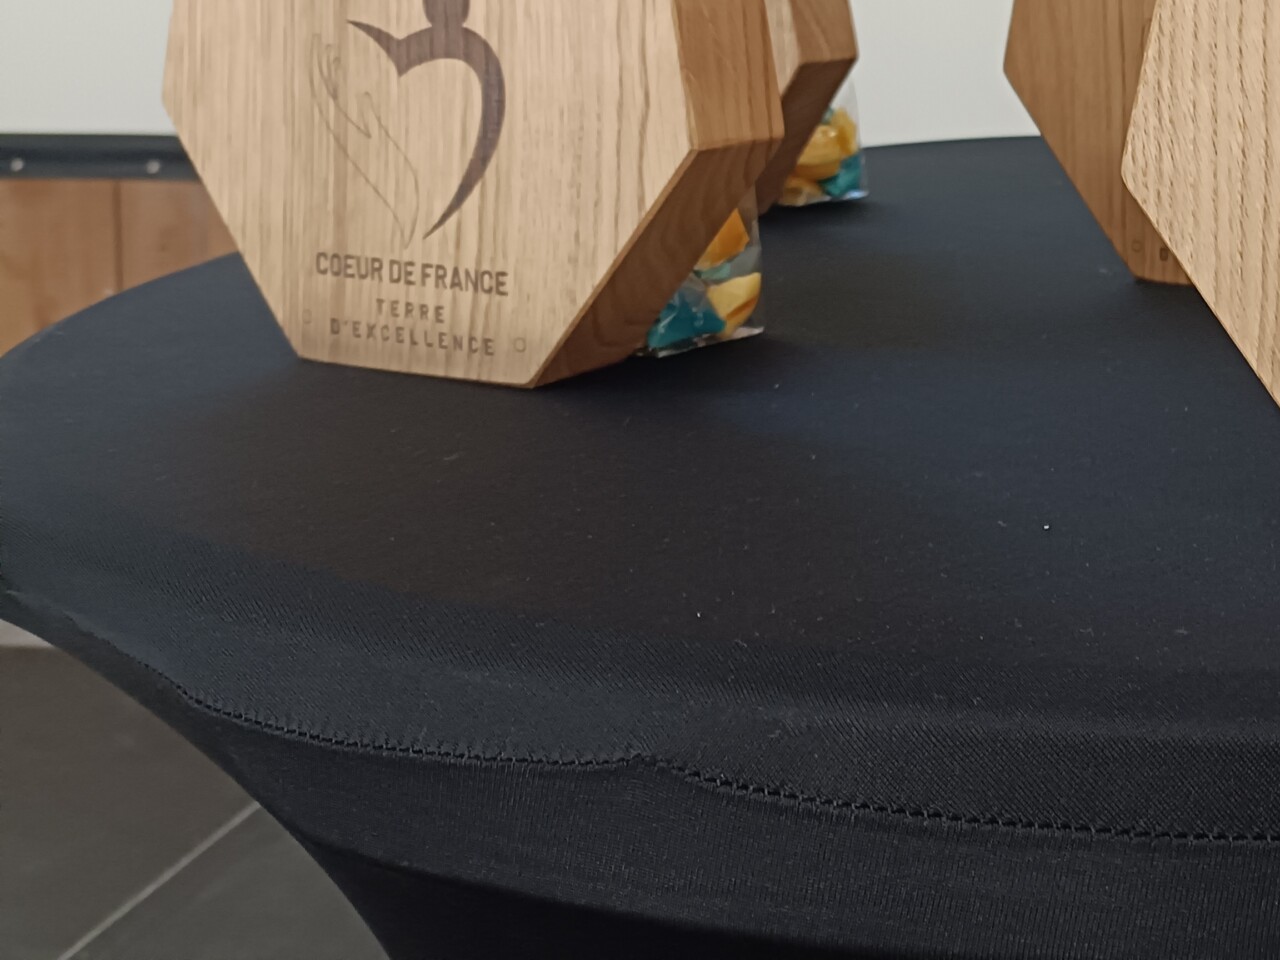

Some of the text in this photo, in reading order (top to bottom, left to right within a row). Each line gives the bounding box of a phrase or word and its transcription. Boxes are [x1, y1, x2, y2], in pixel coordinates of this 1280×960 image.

[315, 251, 509, 296] COEUR DE FRANCE
[375, 297, 445, 324] TERRE
[330, 317, 495, 356] D'EXCELLENCE
